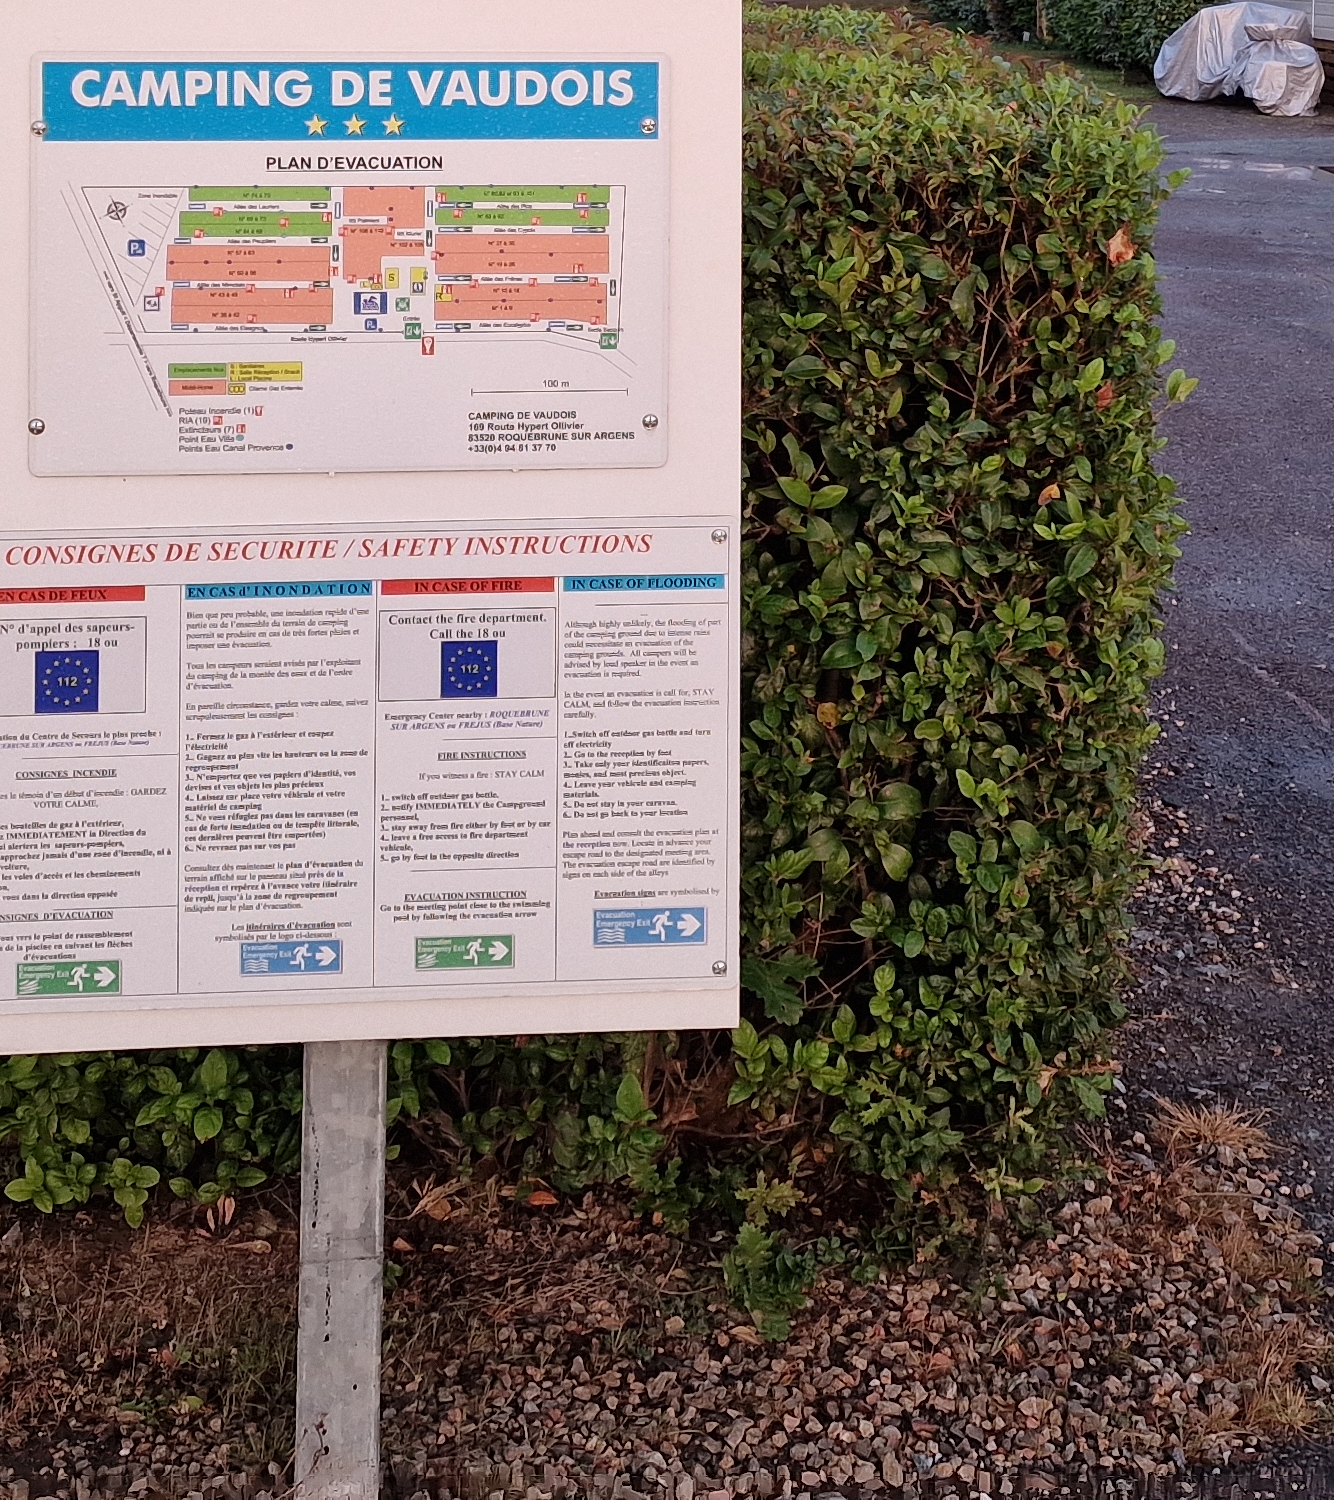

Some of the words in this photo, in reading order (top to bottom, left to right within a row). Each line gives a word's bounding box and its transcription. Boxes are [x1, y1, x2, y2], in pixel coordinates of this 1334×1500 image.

[71, 69, 314, 107] CAMPING
[331, 70, 396, 106] DE
[408, 69, 634, 106] VAUDOIS
[266, 156, 314, 170] PLAN
[318, 156, 443, 171] D'EVACUATION
[498, 433, 568, 441] ROQUEBRUNE
[594, 432, 635, 440] ARGENS
[5, 543, 157, 566] CONSIGNES
[164, 542, 201, 562] DE
[207, 540, 339, 562] SECURITE
[358, 538, 459, 558] SAFETY
[465, 534, 652, 556] INSTRUCTIONS
[415, 583, 429, 592] IN
[432, 582, 467, 592] CASE
[470, 582, 488, 591] OF
[492, 581, 522, 590] FIRE
[572, 580, 585, 589] IN
[590, 579, 623, 589] CASE
[627, 579, 644, 588] OF
[648, 577, 716, 588] FLOODING
[18, 591, 45, 600] CAS
[49, 591, 67, 600] DE
[71, 590, 107, 599] FEUX
[188, 588, 206, 597] EN
[209, 587, 235, 597] CAS
[389, 615, 432, 625] Contact
[436, 614, 453, 624] the
[457, 614, 475, 623] fire
[479, 613, 546, 625] department.
[18, 624, 61, 636] d'appel
[65, 623, 83, 633] des
[87, 623, 135, 634] sapeurs-
[430, 629, 452, 639] Call
[456, 629, 473, 638] the
[477, 628, 489, 638] 18
[16, 638, 70, 651] pompiers
[88, 638, 100, 647] 18
[104, 639, 118, 647] ou
[461, 664, 479, 673] 112
[58, 677, 78, 687] 112
[385, 713, 426, 721] Emergency
[457, 712, 482, 720] nearby
[490, 710, 550, 718] ROQUEBRUNE
[437, 752, 458, 761] FIRE
[461, 750, 526, 760] INSTRUCTIONS
[15, 770, 68, 779] CONSIGNES
[73, 769, 117, 778] INCENDIE
[131, 788, 166, 796] GARDEZ
[34, 801, 63, 809] VOTRE
[416, 802, 479, 810] IMMEDIATELY
[6, 831, 86, 839] IMMEDIATEMENT
[404, 893, 463, 902] EVACUATION
[467, 891, 527, 900] INSTRUCTION
[44, 911, 113, 921] D'EVACUATION
[596, 920, 635, 928] Emergency
